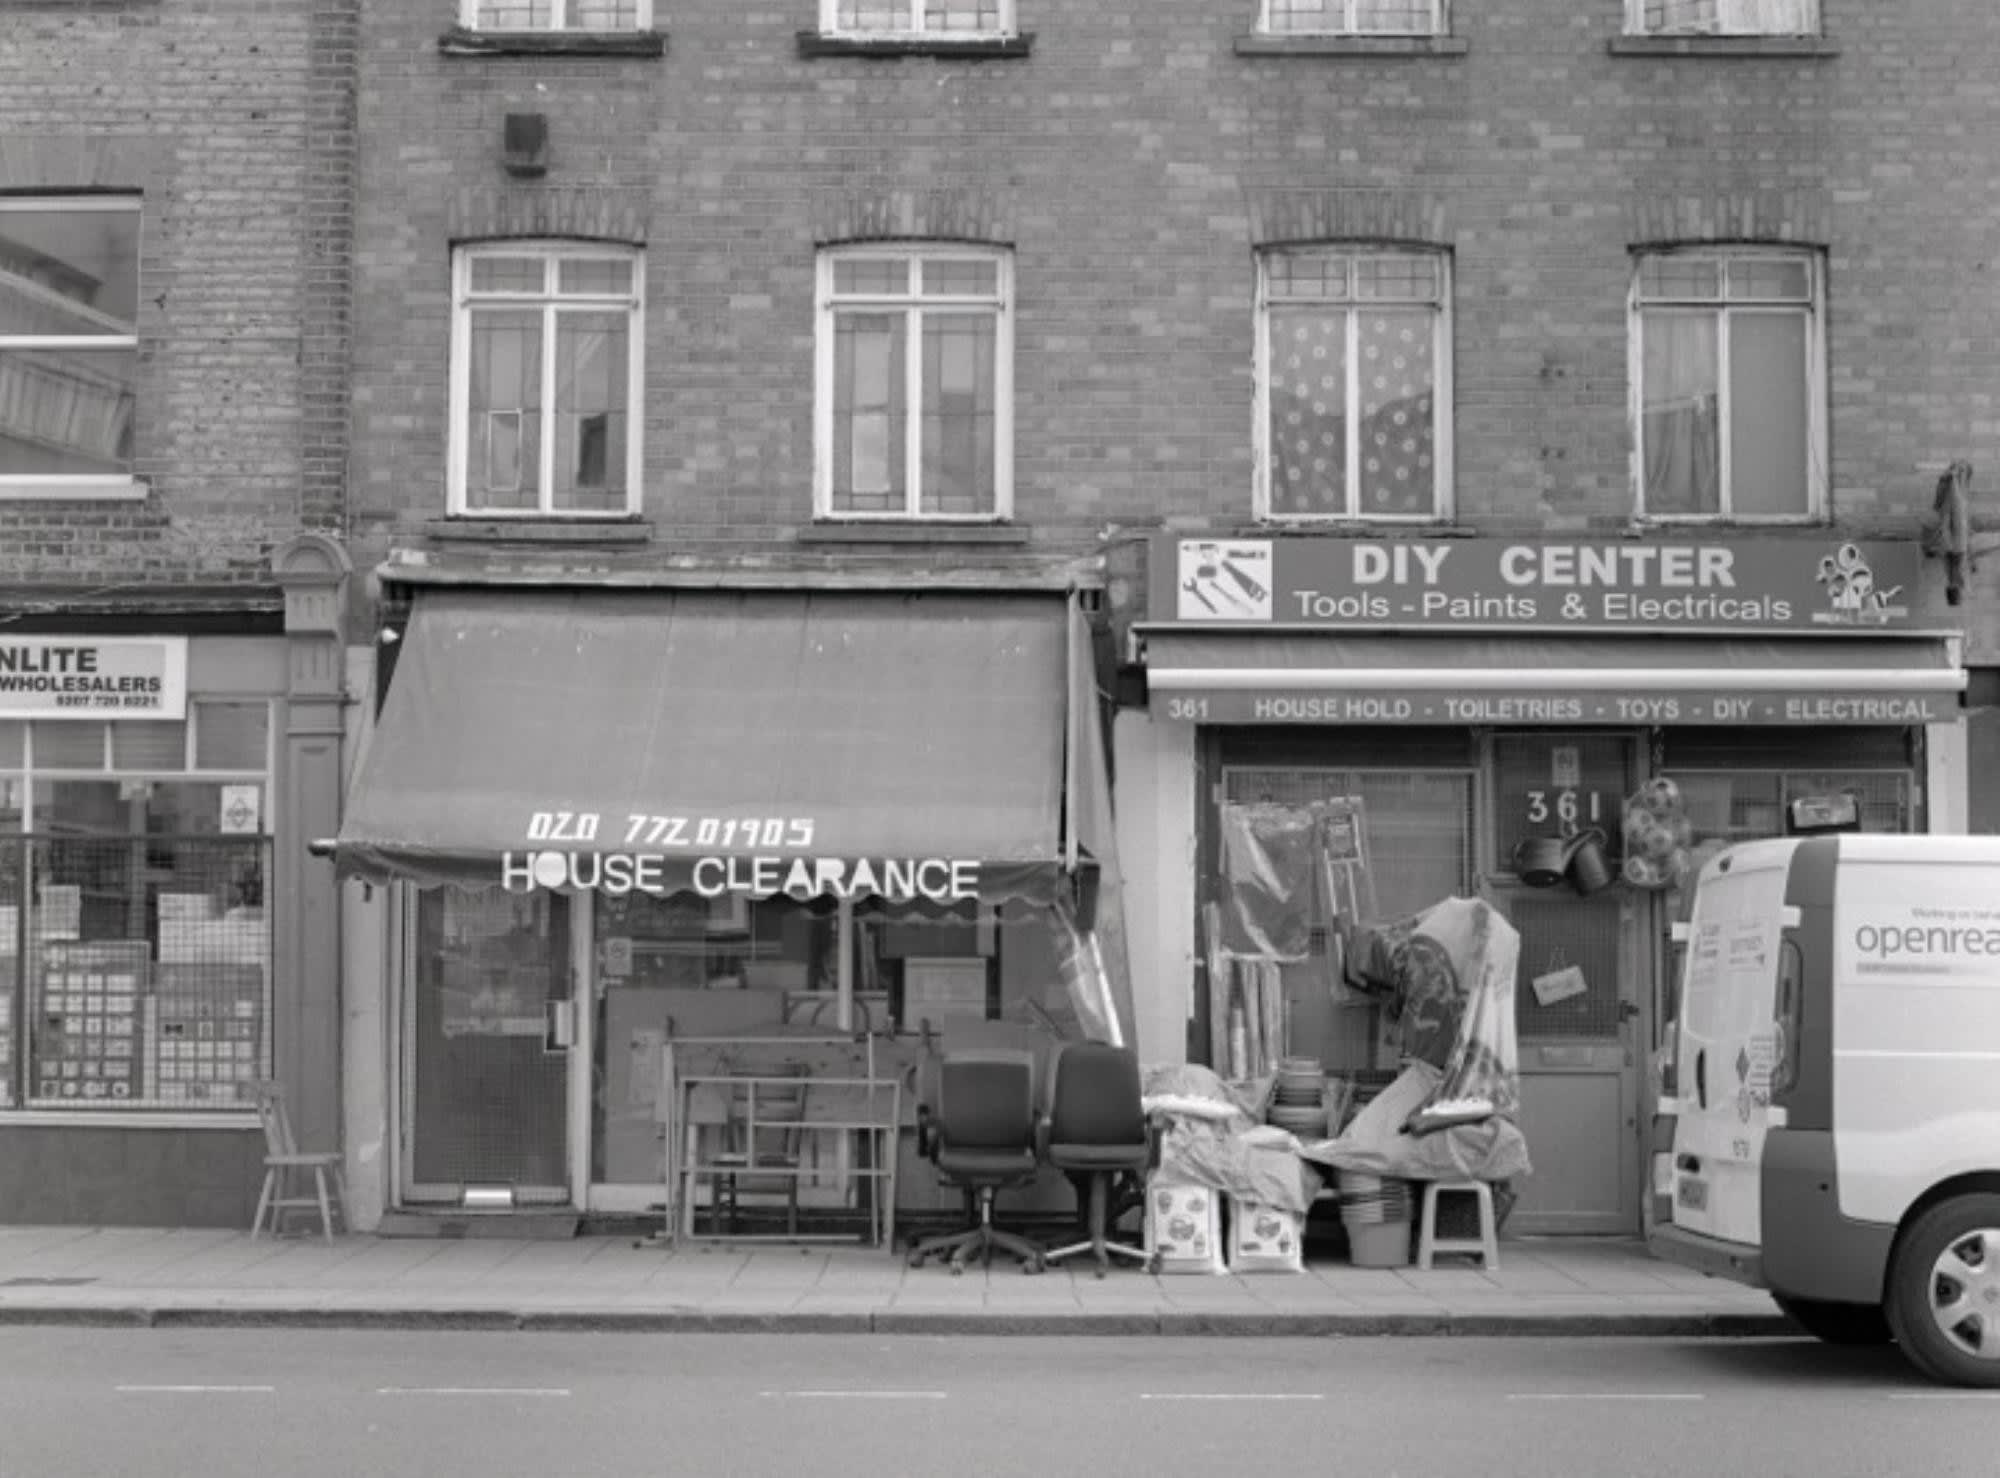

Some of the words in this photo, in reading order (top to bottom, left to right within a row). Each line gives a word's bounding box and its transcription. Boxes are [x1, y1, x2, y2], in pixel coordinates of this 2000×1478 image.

[1353, 545, 1451, 584] DIY
[1500, 546, 1736, 587] CENTER
[1293, 591, 1390, 617] Tools
[1423, 591, 1537, 618] Paints
[1560, 592, 1588, 620] &
[1604, 593, 1792, 620] Electricals
[0, 647, 97, 672] NLITE
[0, 676, 161, 692] WHOLESALERS
[1168, 699, 1208, 719] 361
[1255, 699, 1337, 719] HOUSE
[1346, 699, 1411, 719] HOLD
[1444, 699, 1582, 719] TOILETRIES
[1616, 699, 1680, 720] TOYS
[1713, 700, 1752, 719] DIY
[1785, 700, 1934, 720] ELECTRICAL
[1527, 791, 1600, 822] 361
[527, 812, 600, 841] 020
[502, 851, 664, 893] HOUSE
[693, 856, 980, 898] CLEARANCE
[1855, 924, 2000, 958] openrea
